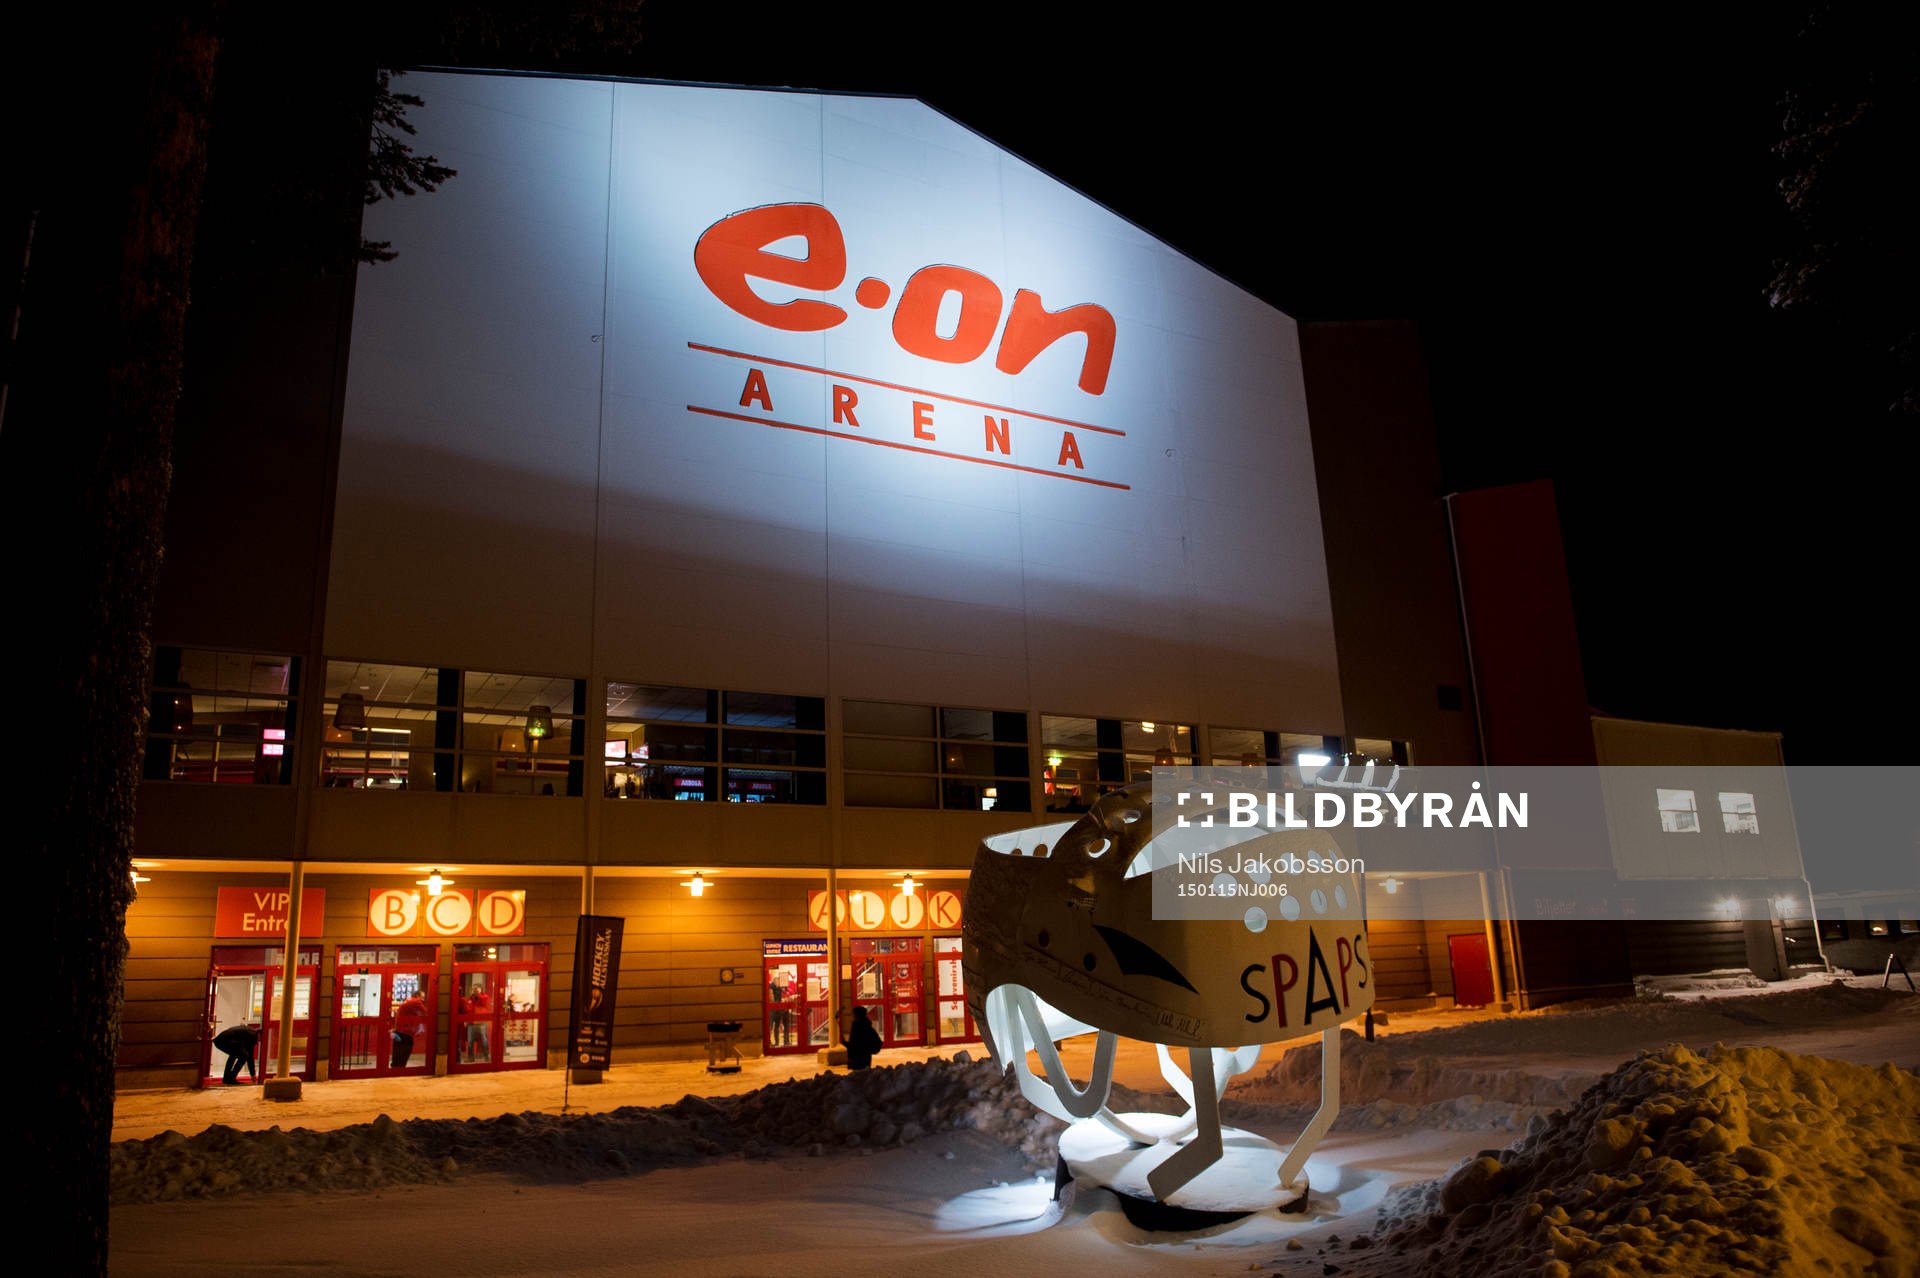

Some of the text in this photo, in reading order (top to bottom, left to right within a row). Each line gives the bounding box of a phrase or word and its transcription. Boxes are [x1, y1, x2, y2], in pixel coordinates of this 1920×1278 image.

[739, 368, 1085, 470] ARENA
[254, 893, 290, 911] VIP
[384, 895, 517, 930] B C D
[863, 896, 875, 925] L
[900, 896, 911, 925] J
[937, 895, 955, 924] K
[591, 933, 606, 987] HOCKEY
[783, 943, 829, 953] RESTAURAN
[1240, 924, 1368, 1028] SPAPS
